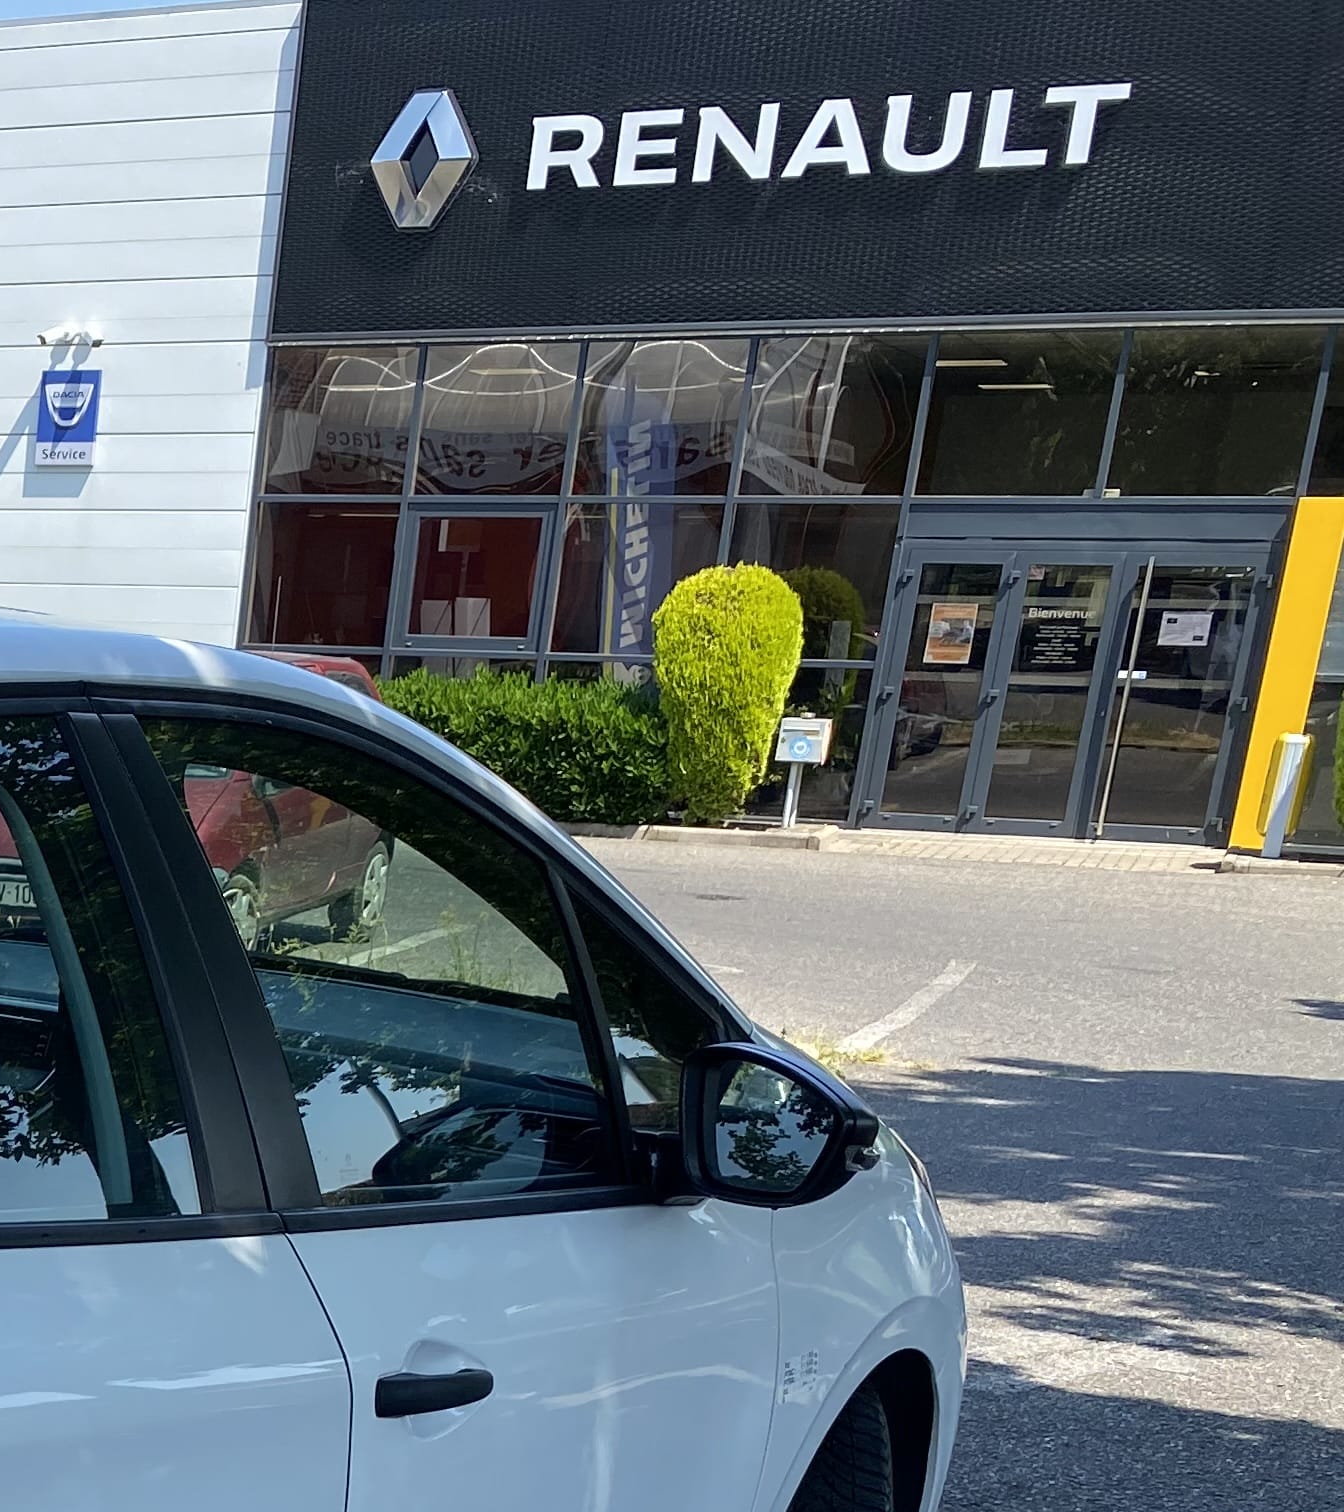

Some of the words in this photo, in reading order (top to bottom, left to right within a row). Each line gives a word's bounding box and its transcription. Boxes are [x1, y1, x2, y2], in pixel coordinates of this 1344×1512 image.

[524, 82, 1133, 191] RENAULT
[52, 391, 85, 399] DACIA
[41, 448, 86, 460] Service
[619, 418, 652, 649] MICHELIN
[1028, 607, 1097, 619] Bienvenue
